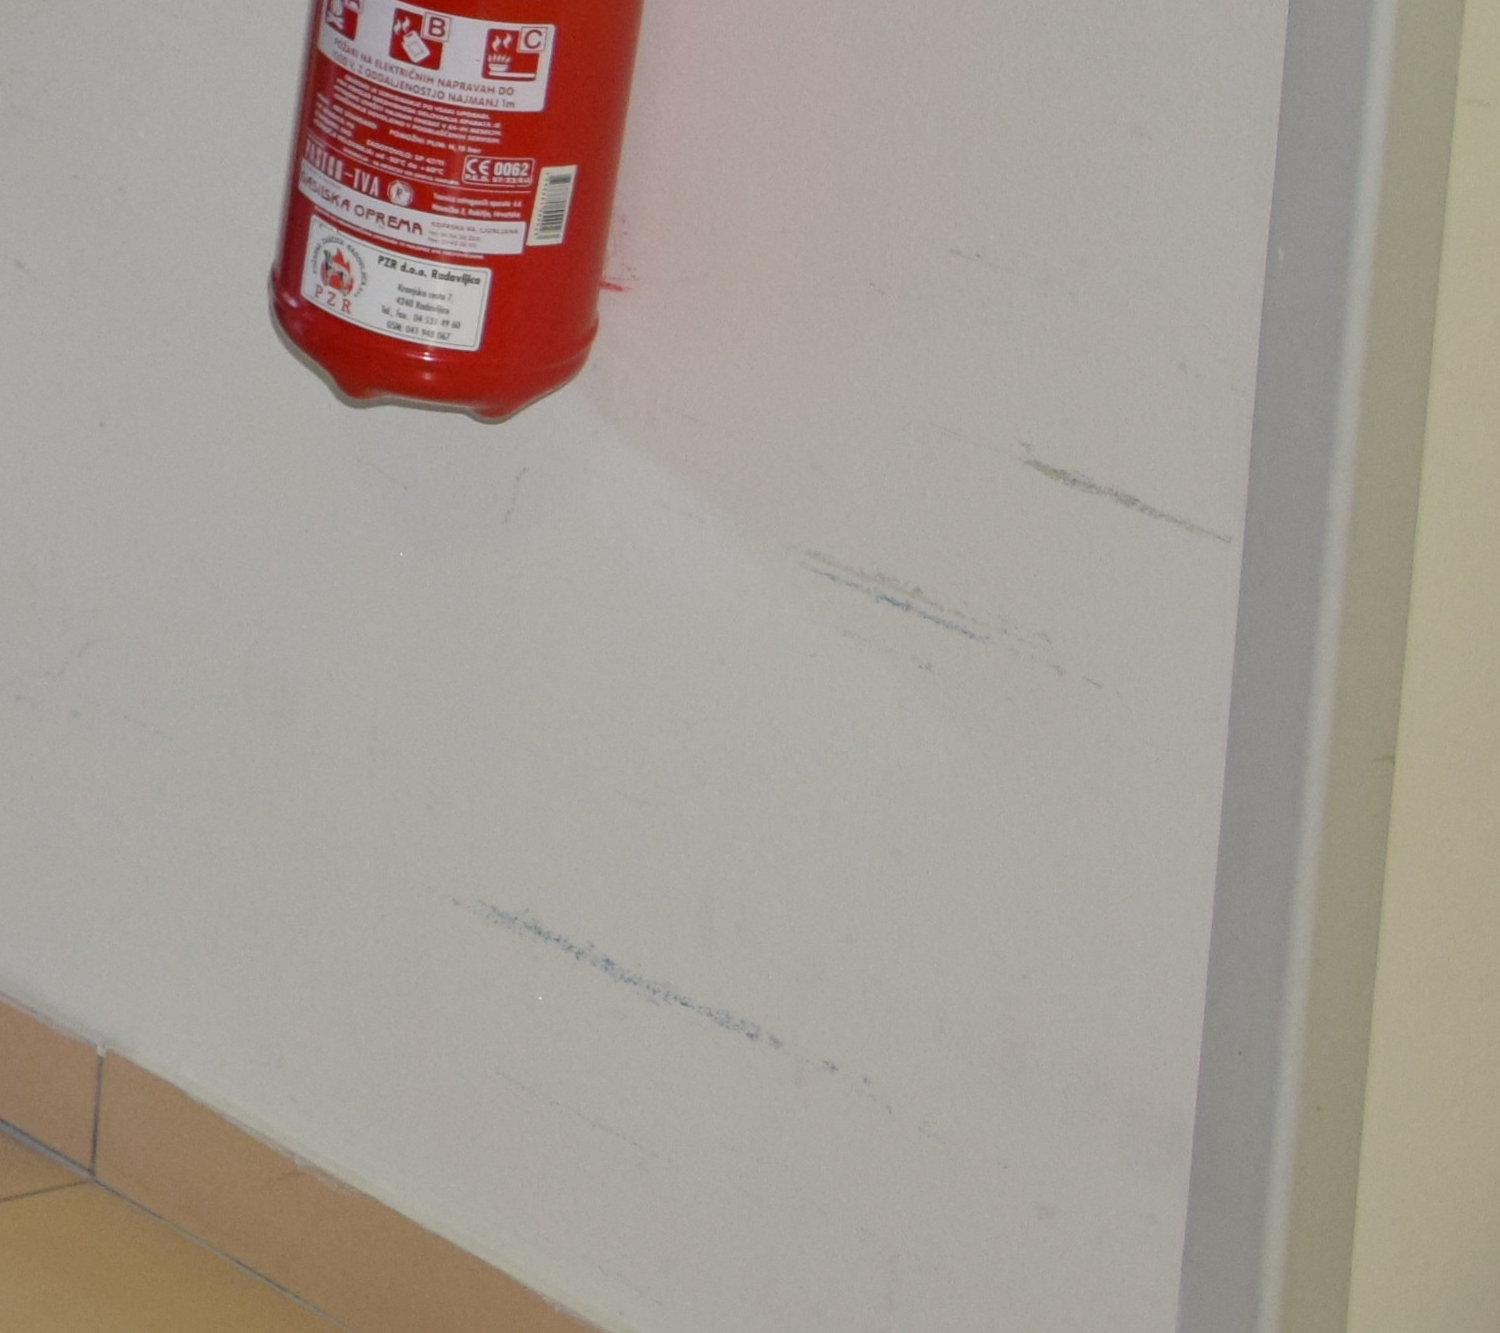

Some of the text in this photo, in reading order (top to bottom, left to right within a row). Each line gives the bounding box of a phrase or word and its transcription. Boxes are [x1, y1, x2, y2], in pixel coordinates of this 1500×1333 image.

[427, 16, 446, 38] B
[523, 29, 543, 49] C
[437, 77, 495, 96] NAPRAVAH
[447, 92, 499, 109] NAJMANJ
[494, 162, 530, 176] 0062
[354, 204, 423, 235] OPREMA
[377, 255, 397, 269] PZR
